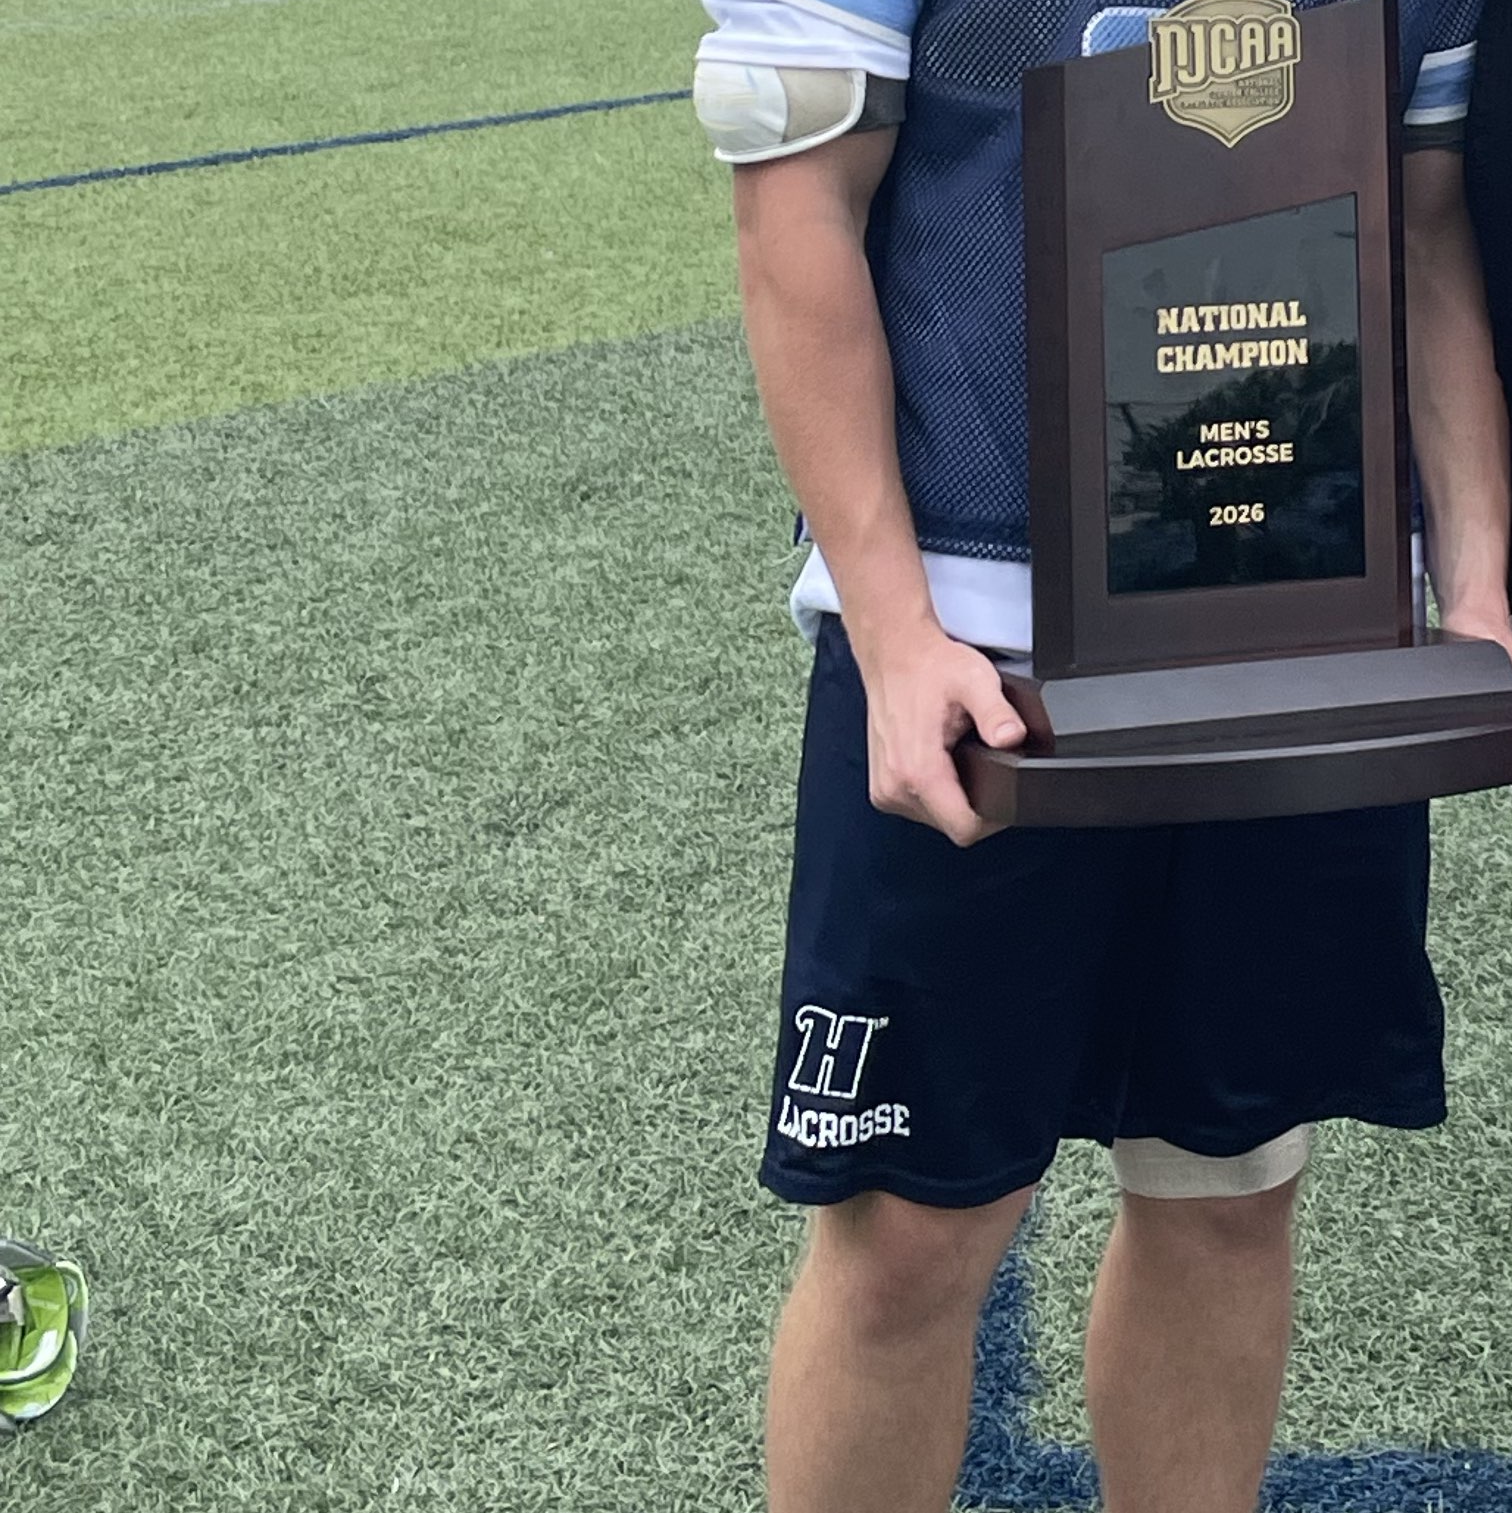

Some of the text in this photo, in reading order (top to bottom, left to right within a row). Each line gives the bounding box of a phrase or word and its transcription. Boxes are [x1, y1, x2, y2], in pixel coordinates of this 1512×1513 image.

[1156, 19, 1294, 93] NJCAA
[1156, 300, 1307, 334] NATIONAL
[1156, 338, 1308, 373] CHAMPION
[1199, 420, 1270, 443] MEN'S
[1176, 443, 1294, 470] LACROSSE
[1208, 502, 1266, 528] 2026
